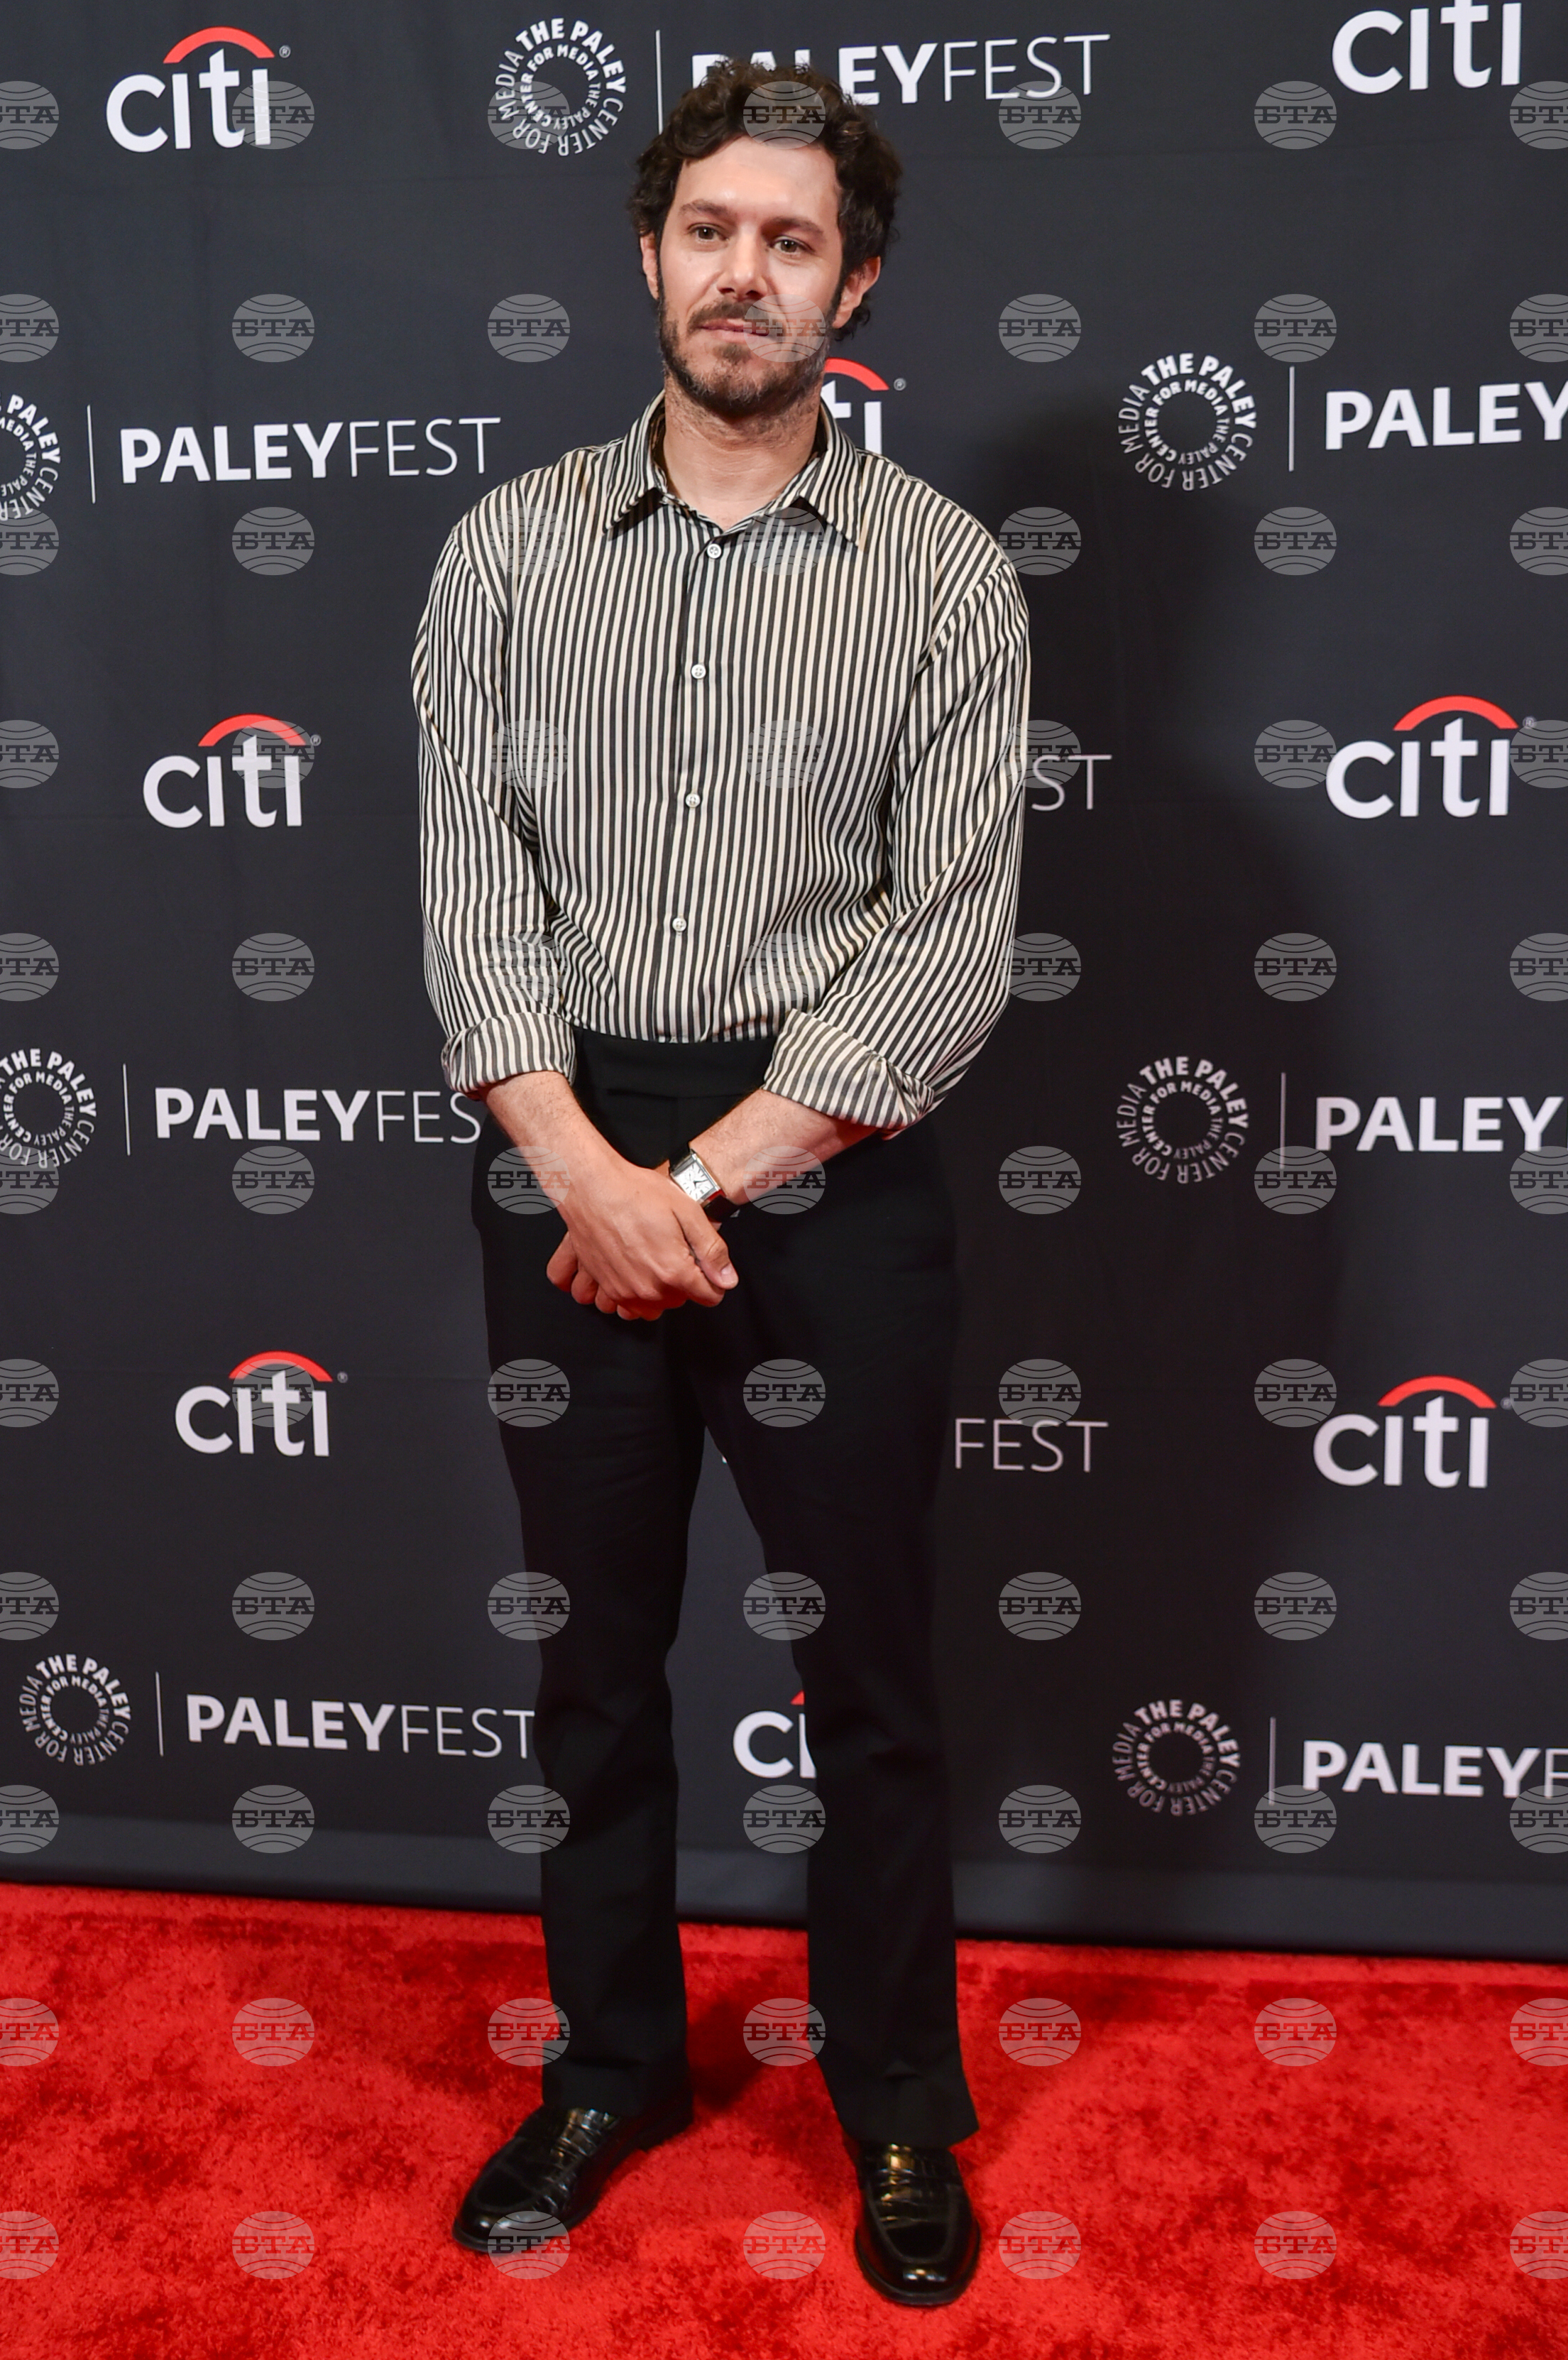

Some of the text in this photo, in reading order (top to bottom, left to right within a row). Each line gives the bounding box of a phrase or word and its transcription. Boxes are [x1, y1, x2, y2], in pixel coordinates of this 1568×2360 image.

[1332, 0, 1522, 94] citi
[105, 48, 271, 153] citi
[495, 18, 626, 156] THE PALEY CENTER FOR MEDIA
[520, 44, 601, 130] THE PALEY CENTER FOR MEDIA
[7, 394, 61, 464] PALEY
[121, 417, 501, 484] PALEYFEST
[1118, 353, 1256, 491] THE PALEY CENTER FOR MEDIA
[1144, 379, 1229, 464] THE PALEY CENTER FOR MEDIA
[23, 452, 36, 476] THE
[143, 734, 302, 829] citi
[1326, 718, 1510, 819] citi
[0, 1049, 97, 1169] THE PALEY CENTER FOR
[3, 1071, 75, 1146] THE PALEY CENTER FOR MEDIA
[1116, 1056, 1249, 1184] THE PALEY CENTER FOR MEDIA
[1149, 1083, 1178, 1104] FOR
[1180, 1081, 1222, 1115] MEDIA
[1315, 1096, 1568, 1152] PALEY
[175, 1371, 330, 1457] citi
[1312, 1395, 1488, 1488] citi
[35, 1654, 77, 1679] THE
[82, 1657, 131, 1720] PALEY
[19, 1675, 43, 1732] MEDIA
[186, 1693, 535, 1759] PALEYFEST
[1134, 1699, 1183, 1725] THE
[1187, 1703, 1241, 1768] PALEY
[35, 1731, 67, 1762] FOR
[73, 1721, 129, 1766] CENTER
[1112, 1722, 1142, 1781] MEDIA
[1127, 1781, 1165, 1813] FOR
[1170, 1769, 1237, 1816] CENTER
